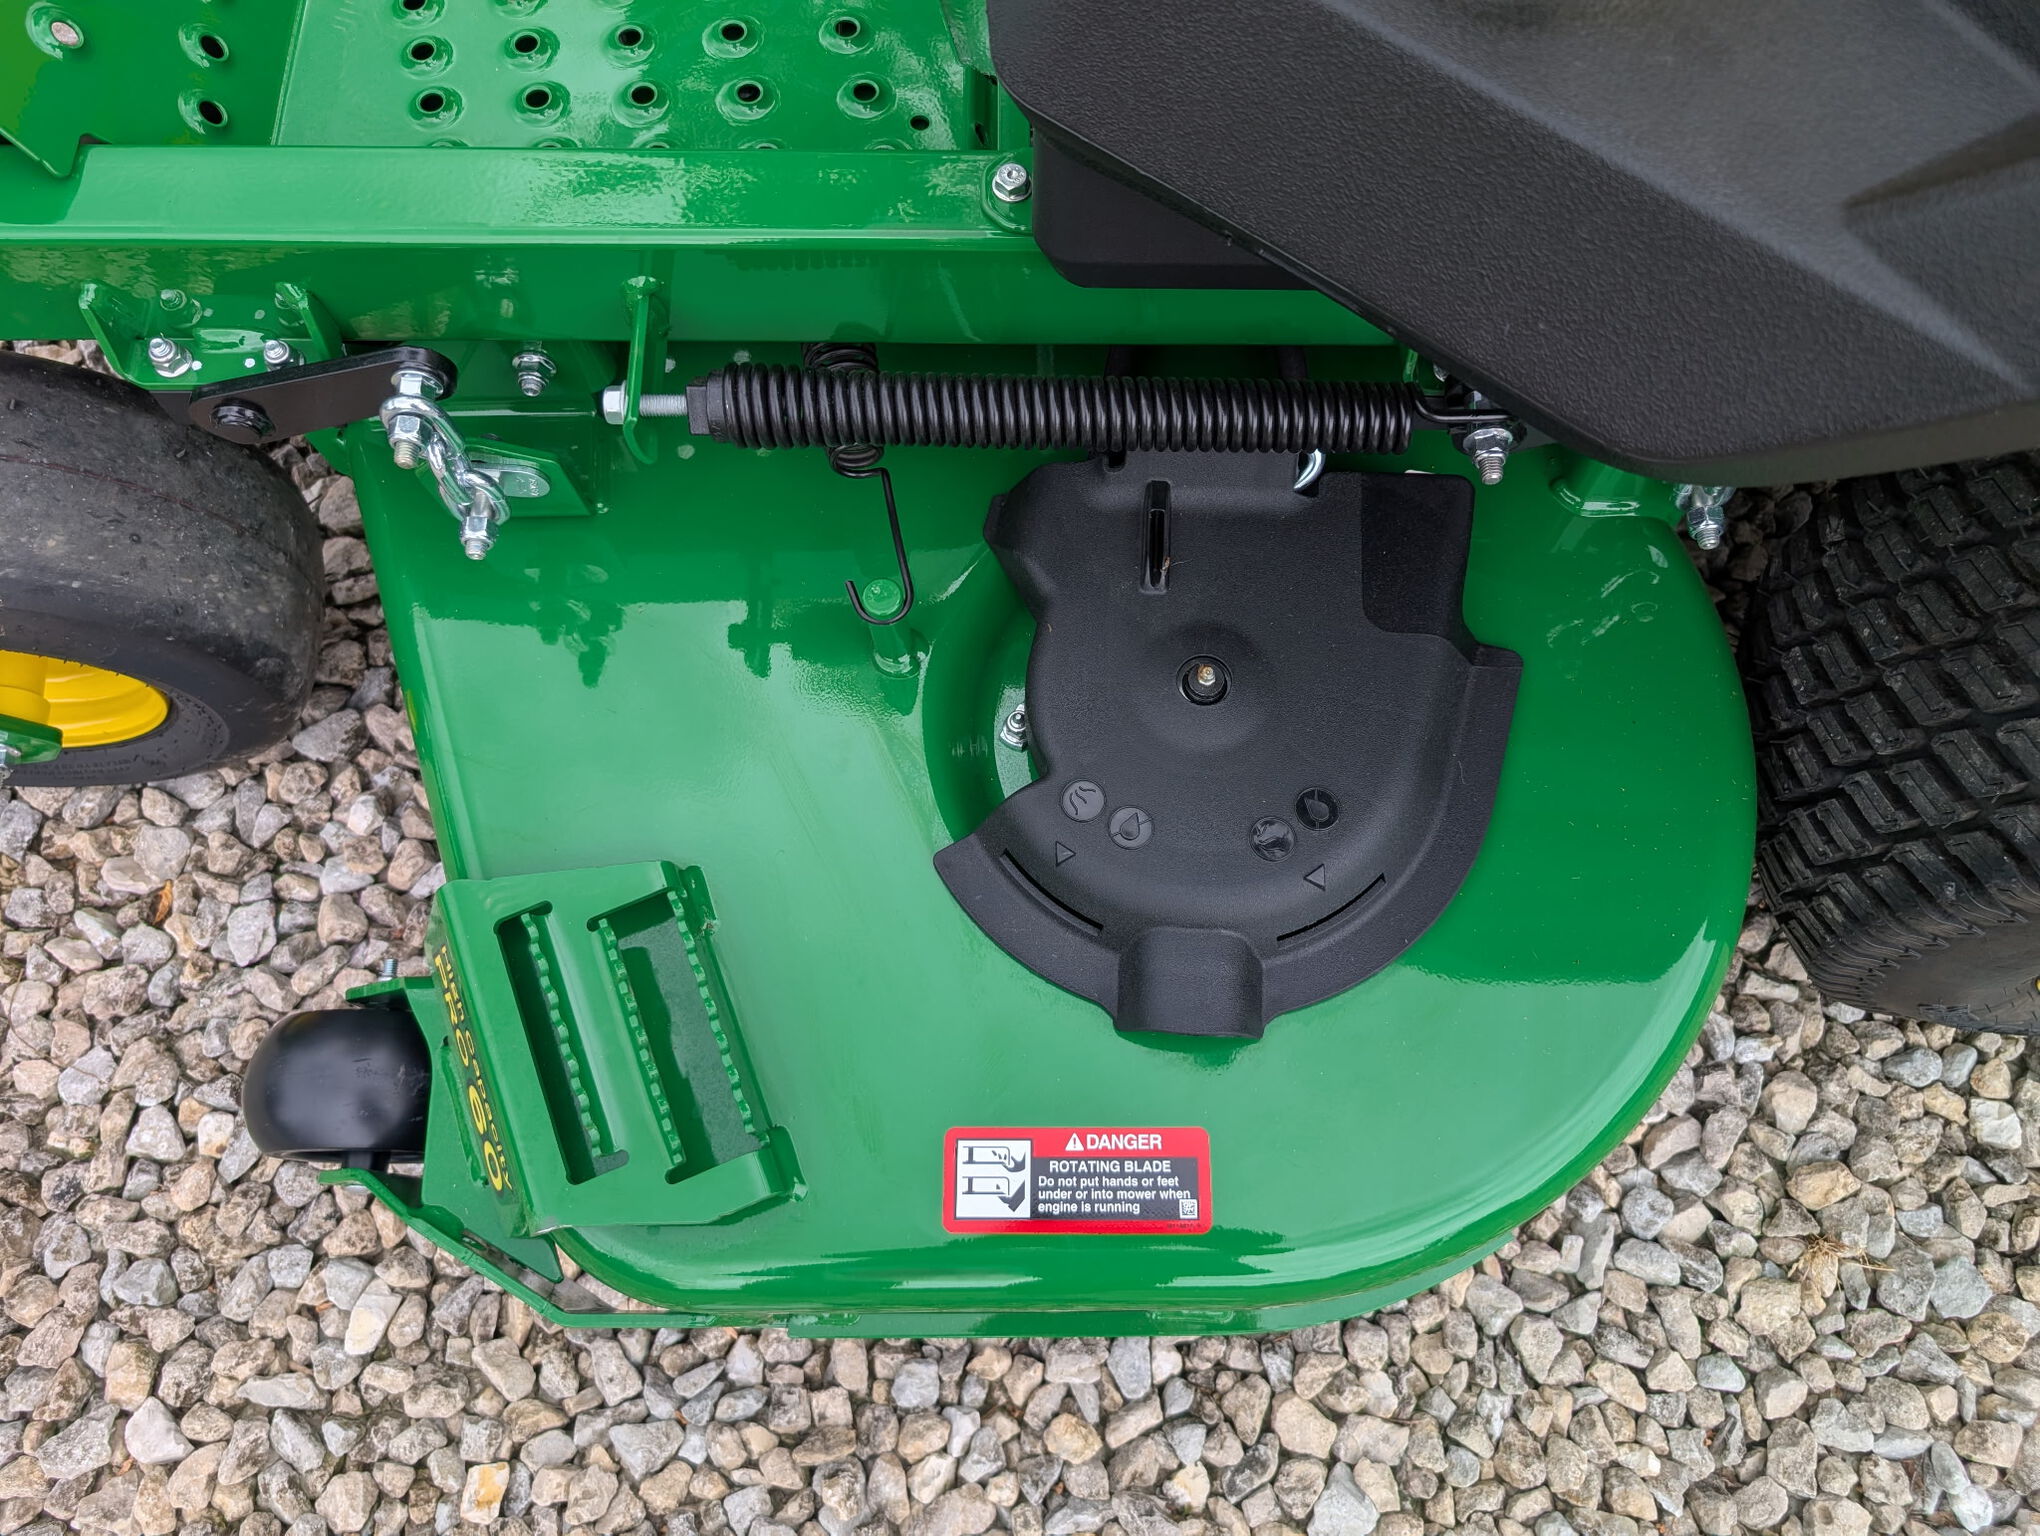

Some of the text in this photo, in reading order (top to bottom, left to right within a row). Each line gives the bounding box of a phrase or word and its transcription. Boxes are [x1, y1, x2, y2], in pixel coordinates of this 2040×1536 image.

[434, 955, 503, 1191] PRO 60
[1086, 1133, 1162, 1150] DANGER
[1050, 1160, 1172, 1173] ROTATING BLADE
[1038, 1176, 1179, 1189] Do not put hands or feet
[1038, 1188, 1191, 1200] under or into mower when
[1038, 1201, 1141, 1215] engine is running
